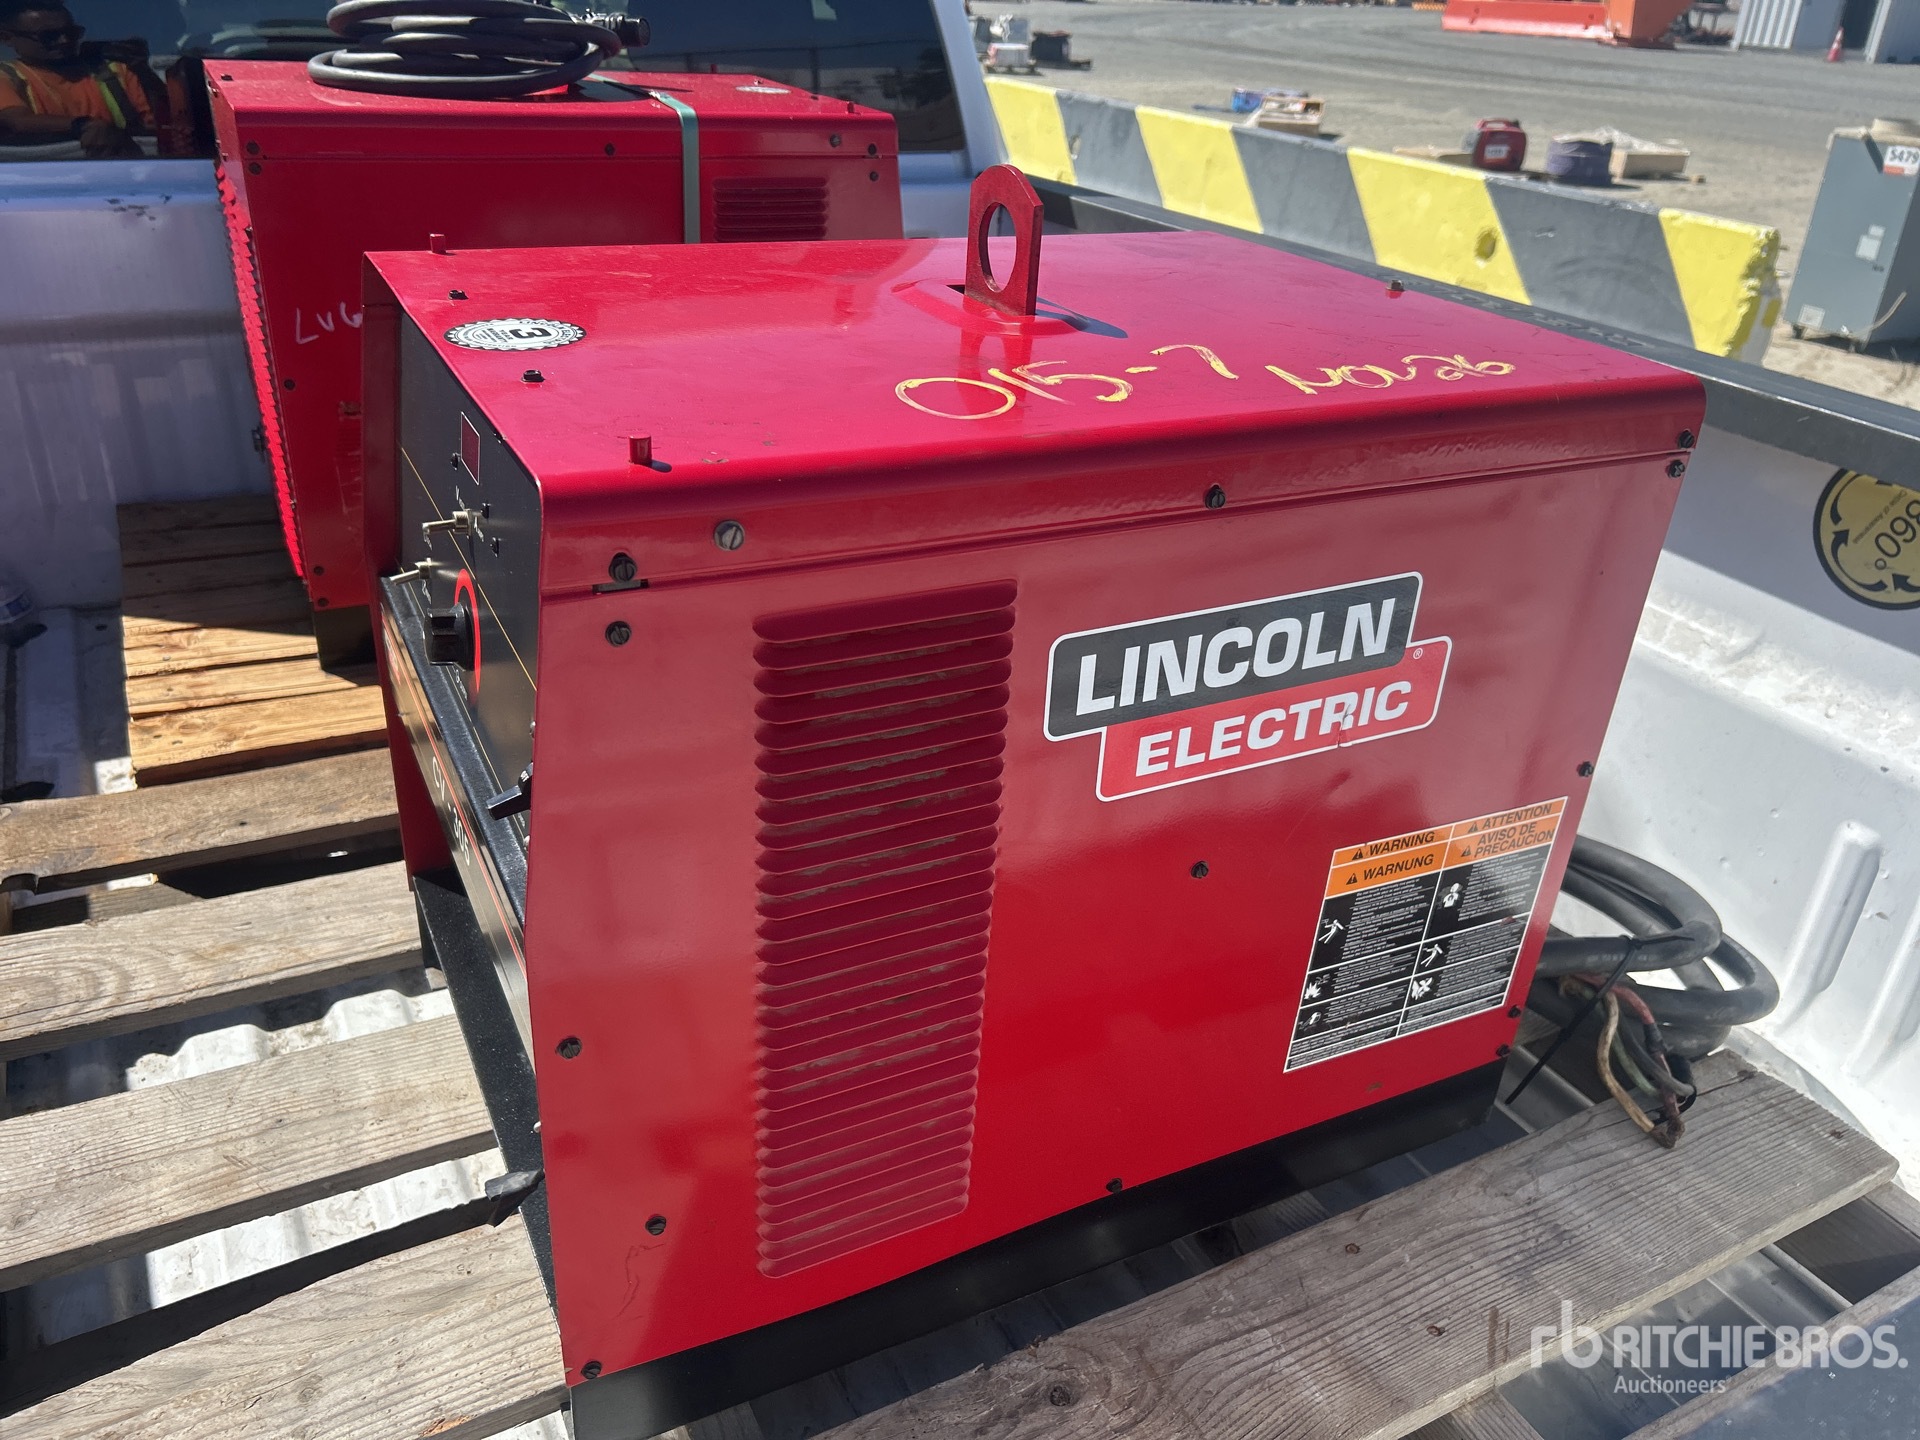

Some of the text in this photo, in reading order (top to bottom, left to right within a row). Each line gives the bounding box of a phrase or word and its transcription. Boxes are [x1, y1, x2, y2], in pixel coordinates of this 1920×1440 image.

[509, 327, 551, 339] 3
[1076, 598, 1396, 716] LINCOLN
[1135, 680, 1412, 777] ELECTRIC
[1481, 804, 1553, 830] ATTENTION
[1368, 831, 1435, 856] WARNING
[1478, 821, 1538, 846] AVISO DE
[1363, 854, 1434, 881] WARNUNG
